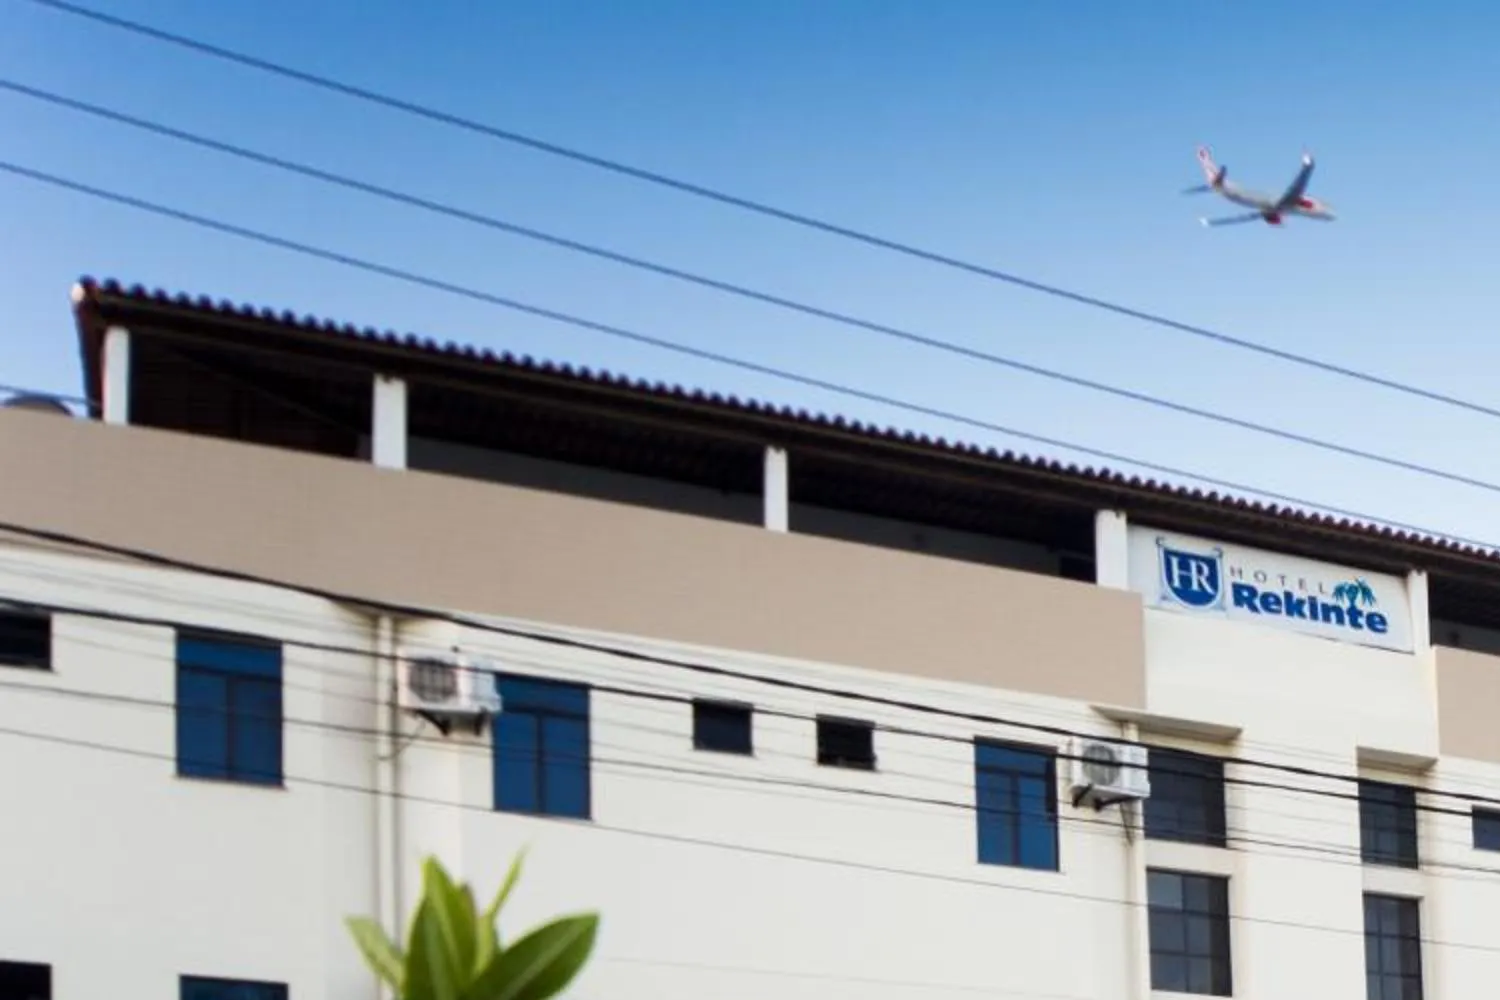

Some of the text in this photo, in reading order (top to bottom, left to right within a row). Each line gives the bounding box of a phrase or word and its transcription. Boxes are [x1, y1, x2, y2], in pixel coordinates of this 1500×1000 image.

[1170, 555, 1215, 595] HR
[1230, 566, 1326, 595] HOTEL
[1231, 581, 1388, 634] Rekinte
